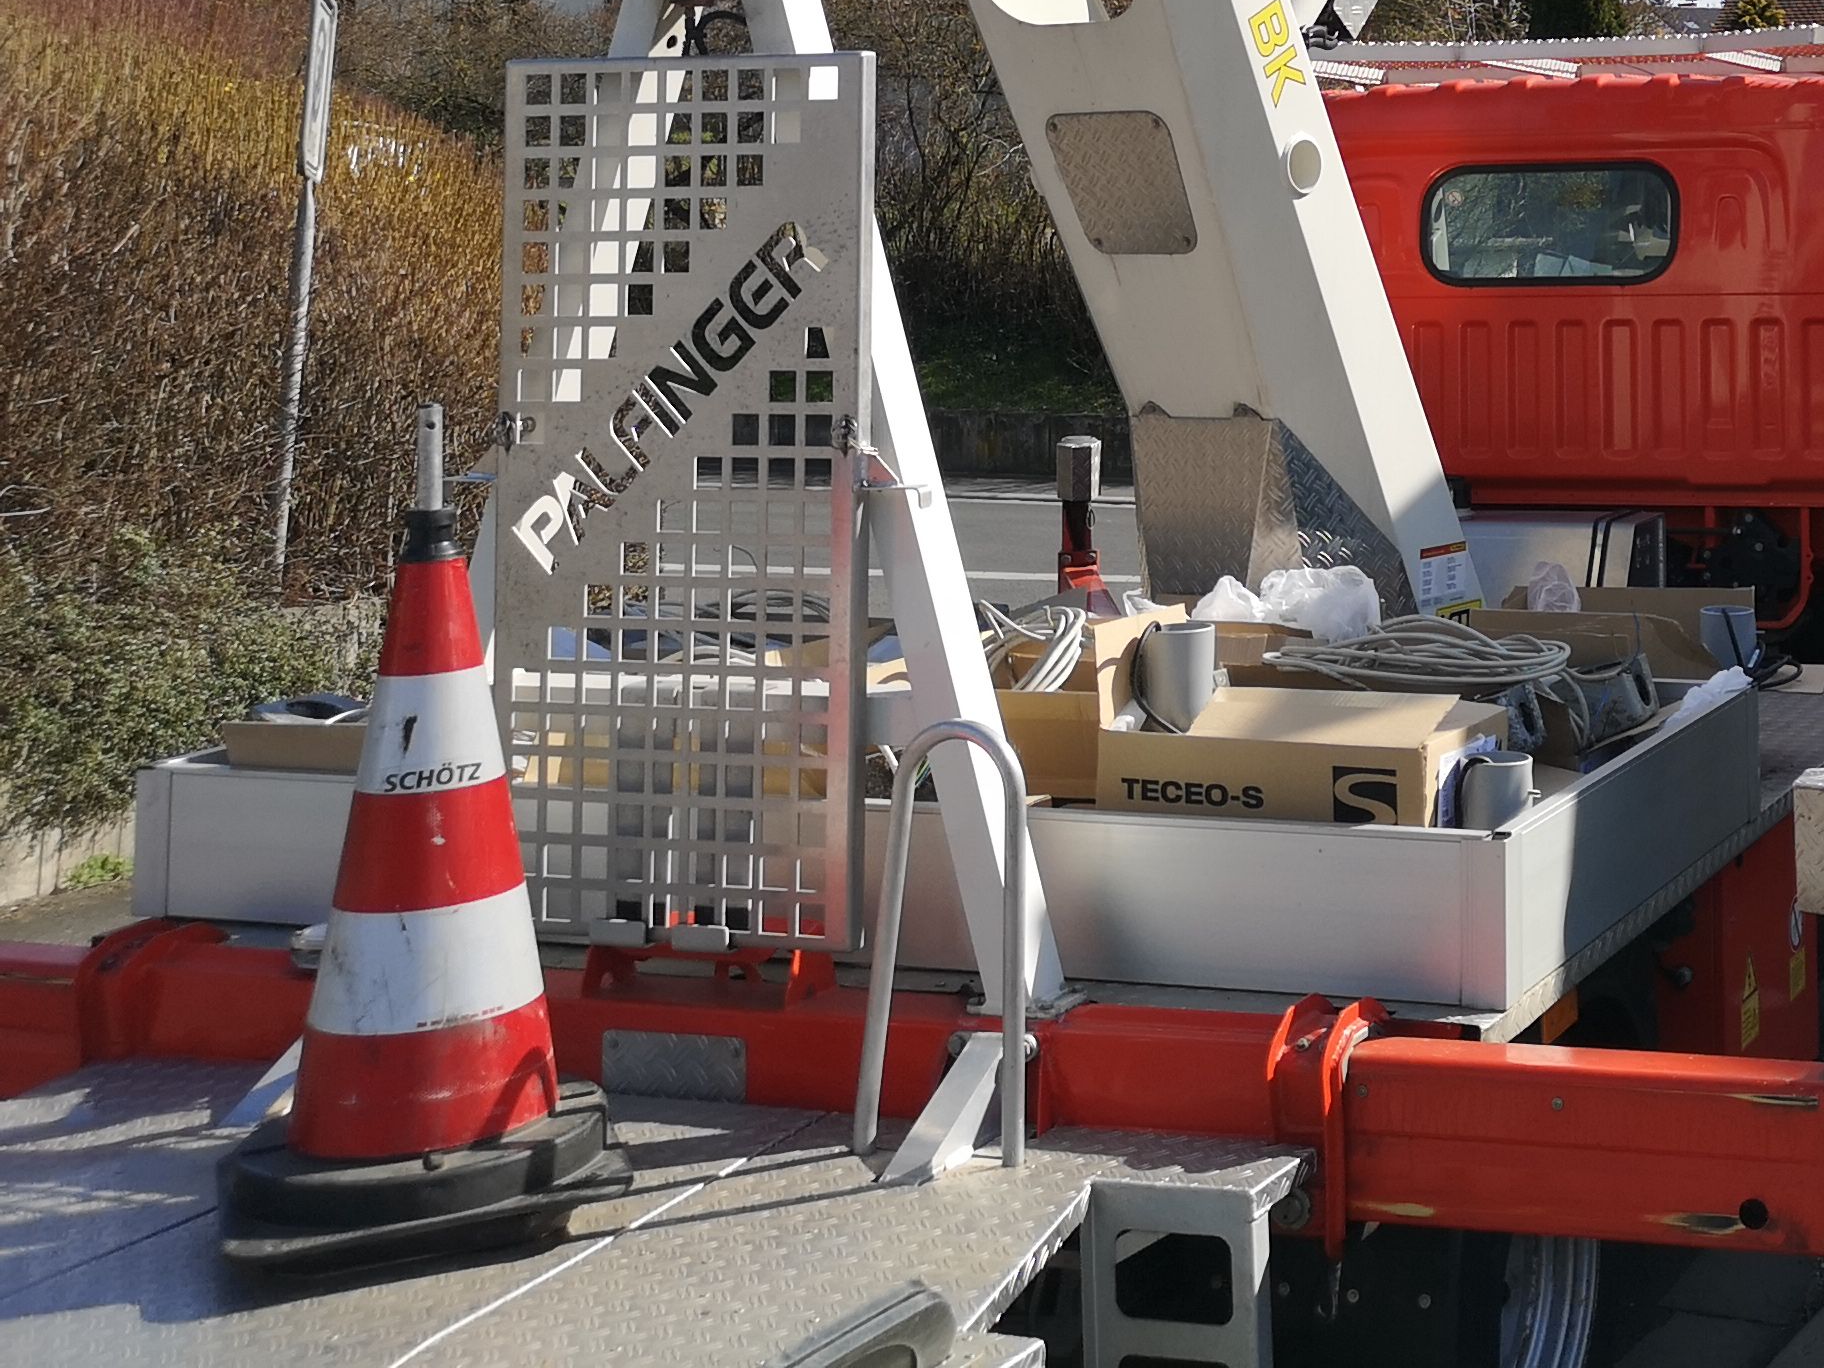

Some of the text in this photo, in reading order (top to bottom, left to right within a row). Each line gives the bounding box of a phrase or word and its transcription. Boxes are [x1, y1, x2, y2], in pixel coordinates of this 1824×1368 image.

[512, 221, 829, 575] PALFINGER
[384, 762, 482, 793] SCHÖTZ
[1121, 777, 1264, 810] TECEO-S
